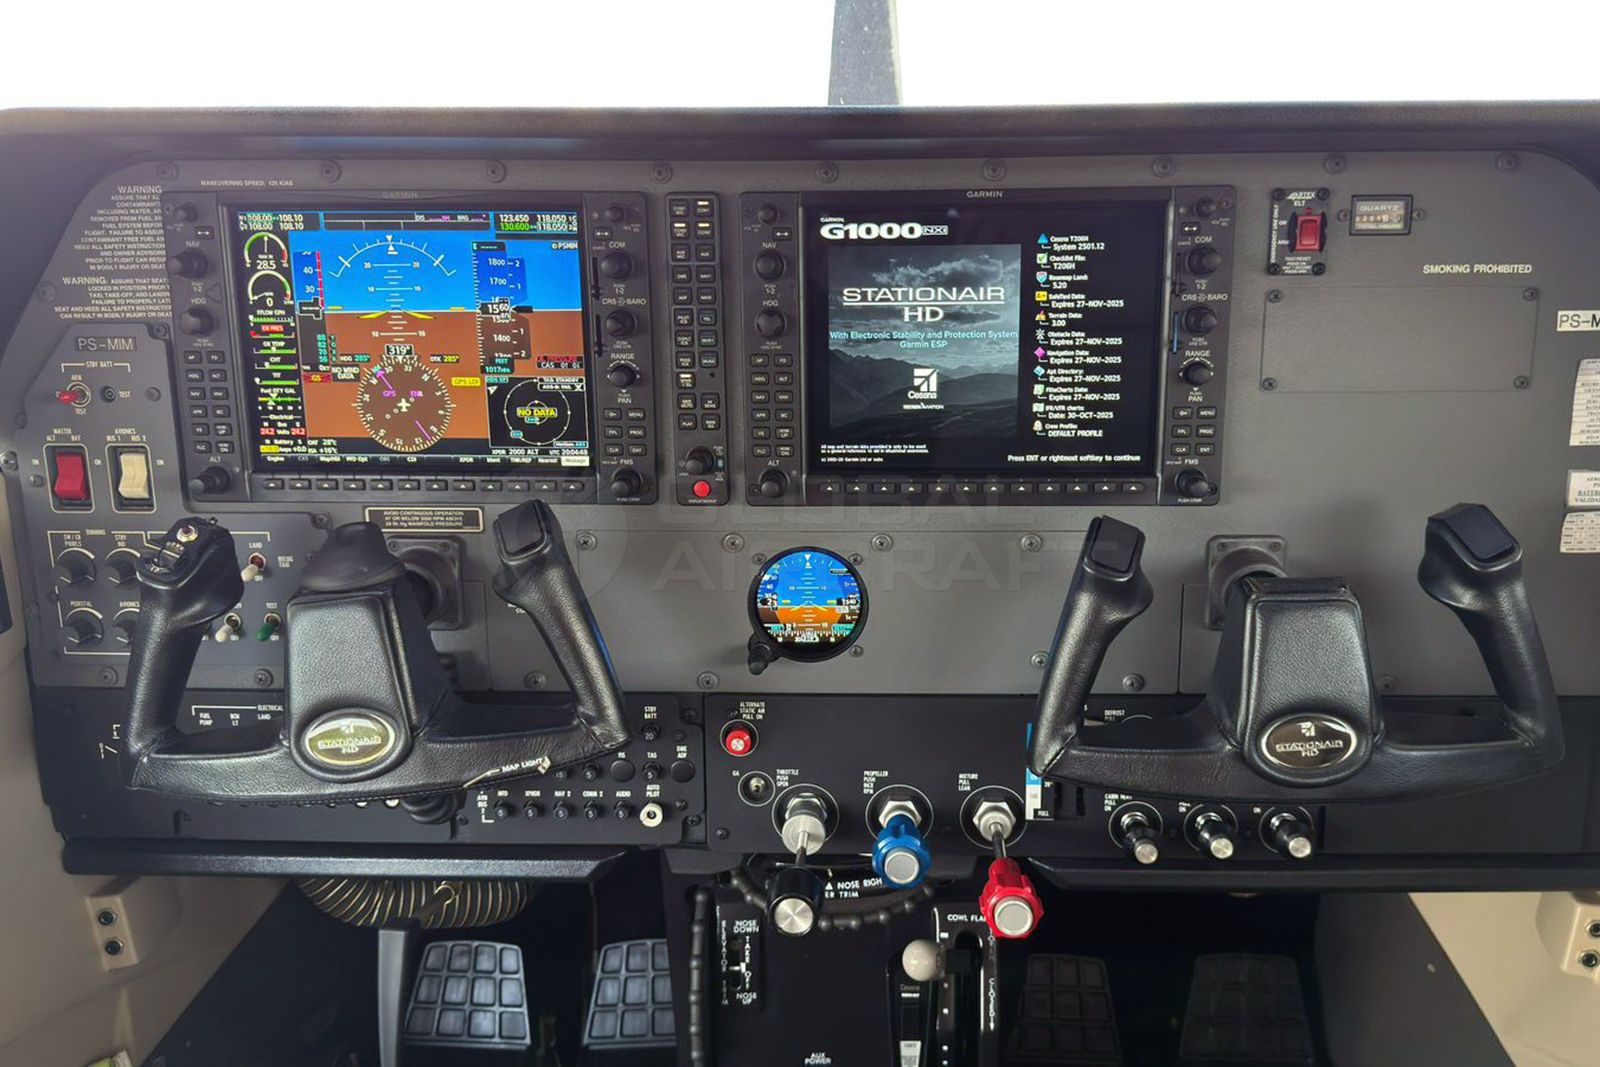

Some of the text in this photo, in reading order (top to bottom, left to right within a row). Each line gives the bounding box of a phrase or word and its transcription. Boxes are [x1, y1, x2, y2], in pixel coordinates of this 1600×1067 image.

[820, 222, 922, 239] G1000
[1053, 244, 1076, 252] System
[257, 261, 276, 269] 28.5
[488, 258, 506, 266] 1800
[1423, 264, 1532, 274] SMOKING PROHIBITED
[489, 277, 507, 285] 1700
[843, 286, 1004, 302] STATIONAIR
[904, 307, 944, 322] HD
[851, 331, 890, 339] Electronic
[892, 331, 925, 341] Stability
[945, 331, 986, 339] Protection
[988, 331, 1018, 340] System
[388, 346, 410, 355] 319°
[908, 391, 937, 399] Cessna
[317, 736, 382, 750] STATIONAIR
[1276, 740, 1344, 752] STATIONAIR
[1301, 748, 1320, 757] HD
[502, 758, 542, 772] MAP LIGHT
[837, 878, 883, 890] NOSE RIGH
[839, 890, 859, 898] TRIM
